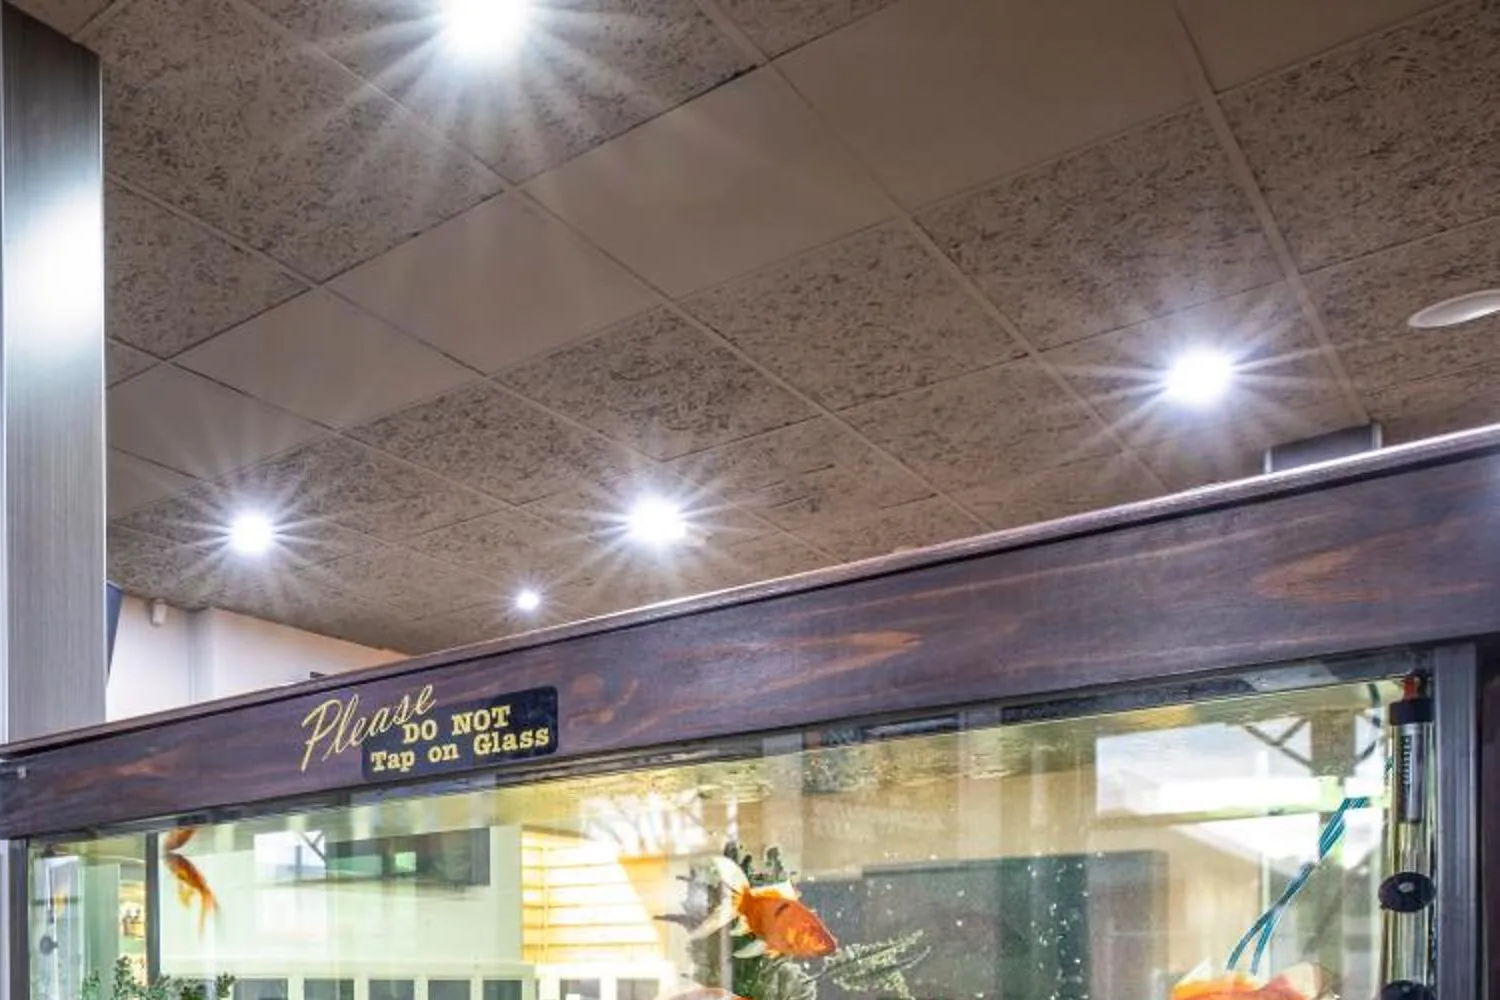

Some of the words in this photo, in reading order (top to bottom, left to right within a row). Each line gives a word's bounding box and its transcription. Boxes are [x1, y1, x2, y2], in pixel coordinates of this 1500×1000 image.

[301, 684, 436, 772] Please
[403, 719, 437, 744] DO
[451, 705, 511, 736] NOT
[371, 751, 415, 772] Tap
[428, 743, 460, 763] on
[473, 727, 549, 755] Glass
